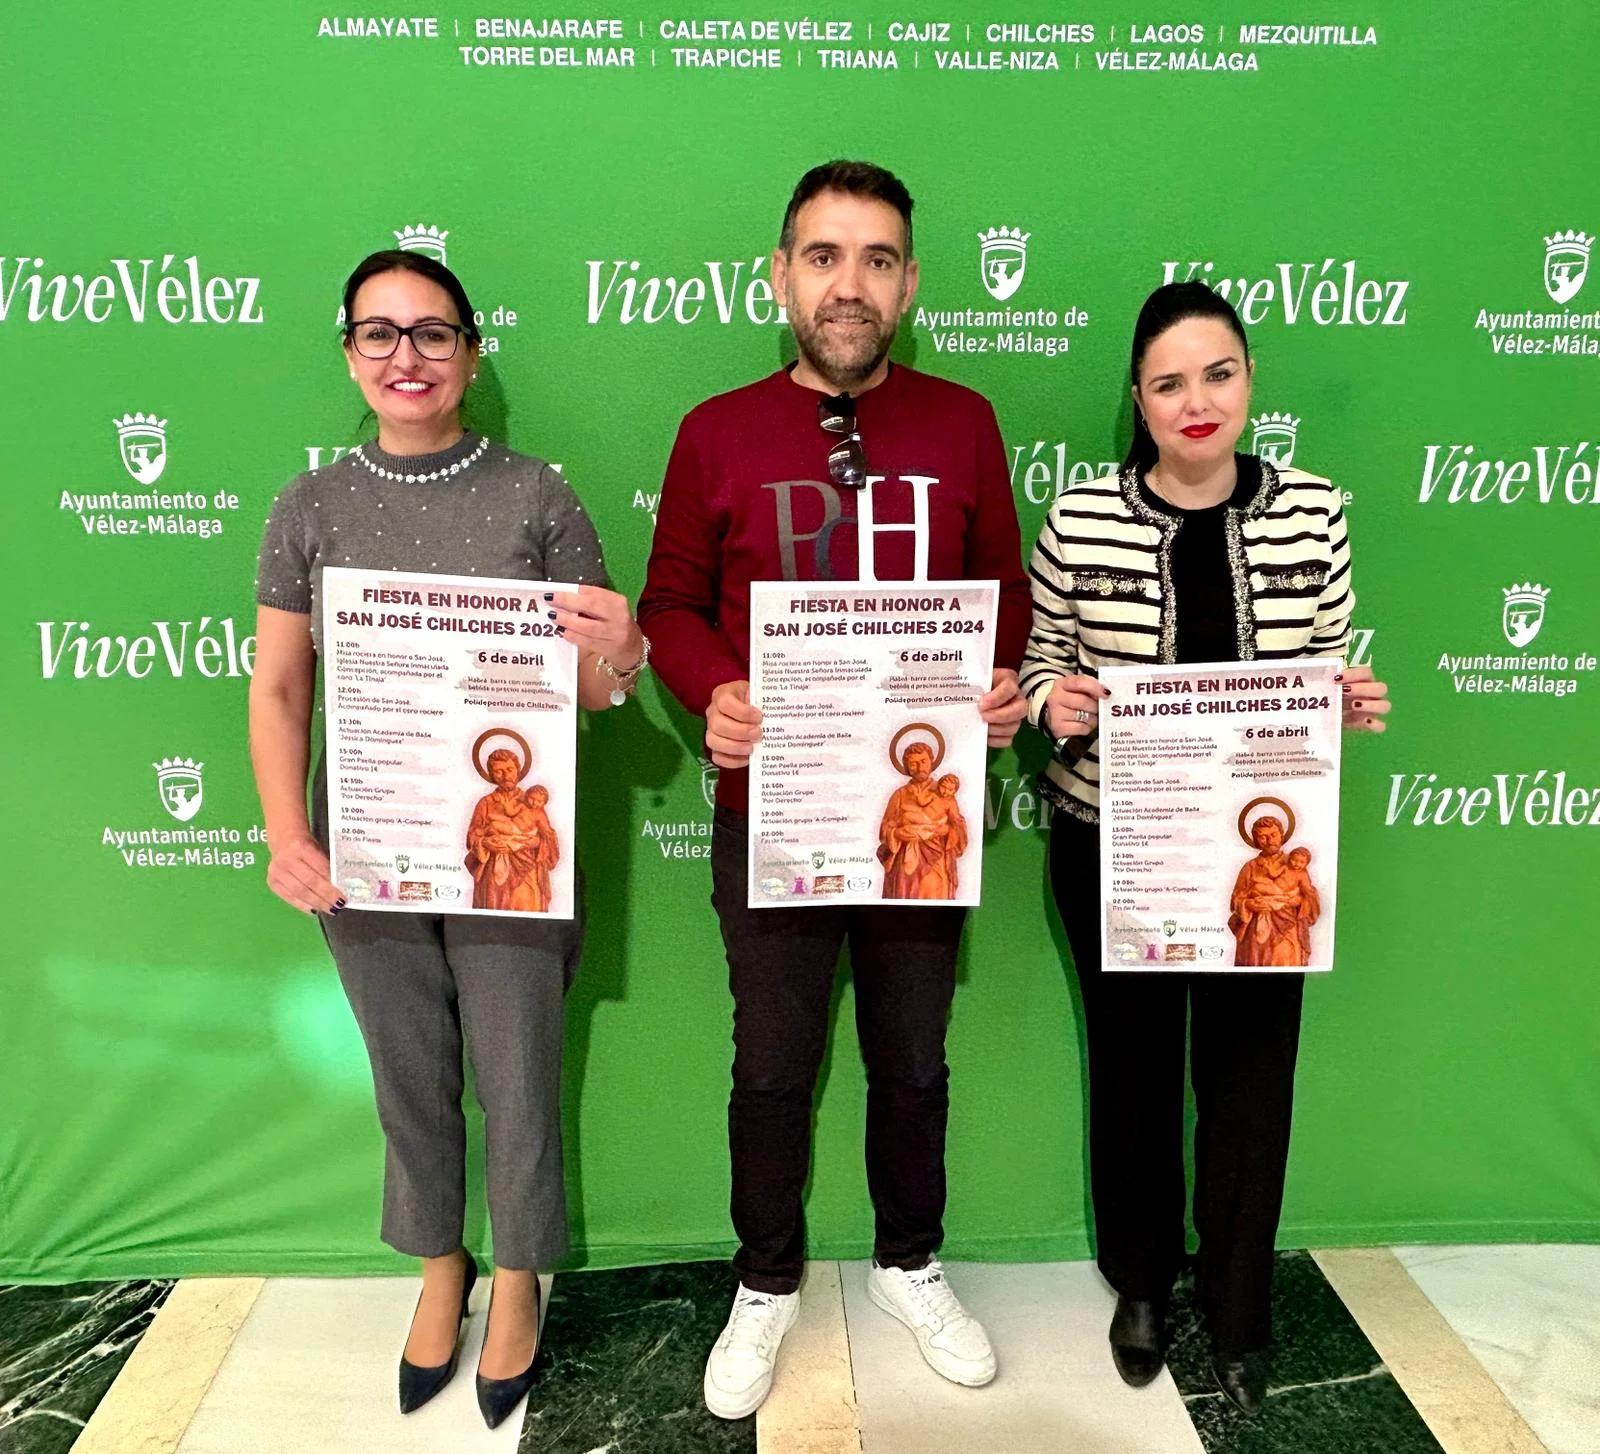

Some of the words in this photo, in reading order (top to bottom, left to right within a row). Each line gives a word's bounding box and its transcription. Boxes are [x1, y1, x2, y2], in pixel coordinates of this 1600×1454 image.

[318, 17, 438, 37] ALMAYATE
[476, 18, 623, 39] BENAJARAFE
[660, 20, 746, 40] CALETA
[751, 21, 780, 40] DE
[785, 17, 852, 40] VÉLEZ
[888, 22, 950, 42] CAJIZ
[986, 24, 1094, 43] CHILCHES
[1131, 24, 1204, 43] LAGOS
[1240, 25, 1376, 45] MEZQUITILLA
[459, 46, 535, 65] TORRE
[540, 48, 582, 66] DEL
[586, 48, 635, 66] MAR
[672, 48, 781, 68] TRAPICHE
[817, 50, 898, 69] TRIANA
[935, 51, 1059, 70] VALLE-NIZA
[1096, 48, 1258, 71] VÉLEZ-MÁLAGA
[493, 308, 517, 328] de
[914, 306, 1056, 328] Ayuntamiento
[1064, 308, 1089, 328] de
[1475, 308, 1600, 333] Ayuntamient
[933, 332, 1069, 357] Vélez-Málaga
[1492, 335, 1600, 358] Vélez-Mála
[60, 490, 208, 515] Ayuntamiento
[214, 491, 238, 510] de
[82, 513, 222, 537] Vélez-Málaga
[363, 588, 423, 606] FIESTA
[427, 592, 451, 608] EN
[456, 594, 522, 612] HONOR
[526, 598, 539, 613] A
[790, 599, 849, 613] FIESTA
[854, 598, 877, 612] EN
[882, 598, 944, 612] HONOR
[950, 597, 961, 612] A
[336, 611, 373, 627] SAN
[378, 612, 422, 629] JOSÉ
[427, 617, 516, 636] CHILCHES
[763, 623, 799, 637] SAN
[804, 618, 847, 636] JOSÉ
[852, 621, 937, 636] CHILCHES
[942, 620, 985, 634] 2024
[478, 651, 487, 663] 6
[490, 652, 508, 664] de
[511, 654, 544, 666] abril
[900, 651, 909, 662] 6
[912, 650, 929, 662] de
[931, 650, 963, 662] abril
[1437, 653, 1568, 674] Ayuntamiento
[1575, 653, 1597, 670] de
[1136, 680, 1193, 695] FIESTA
[1197, 679, 1219, 693] EN
[1225, 676, 1288, 691] HONOR
[1292, 675, 1305, 688] A
[1454, 675, 1577, 696] Vélez-Málaga
[464, 698, 514, 708] Polideportivo
[526, 702, 558, 710] Chilches
[884, 696, 932, 704] Polideportivo
[1111, 704, 1146, 717] SAN
[1150, 698, 1192, 716] JOSÉ
[1196, 698, 1282, 714] CHILCHES
[1286, 696, 1330, 711] 2024
[1245, 728, 1254, 739] 6
[1257, 727, 1274, 739] de
[1276, 726, 1309, 738] abril
[1291, 769, 1322, 777] Chilches
[103, 826, 240, 848] Ayuntamiento
[122, 848, 255, 869] Vélez-Málaga
